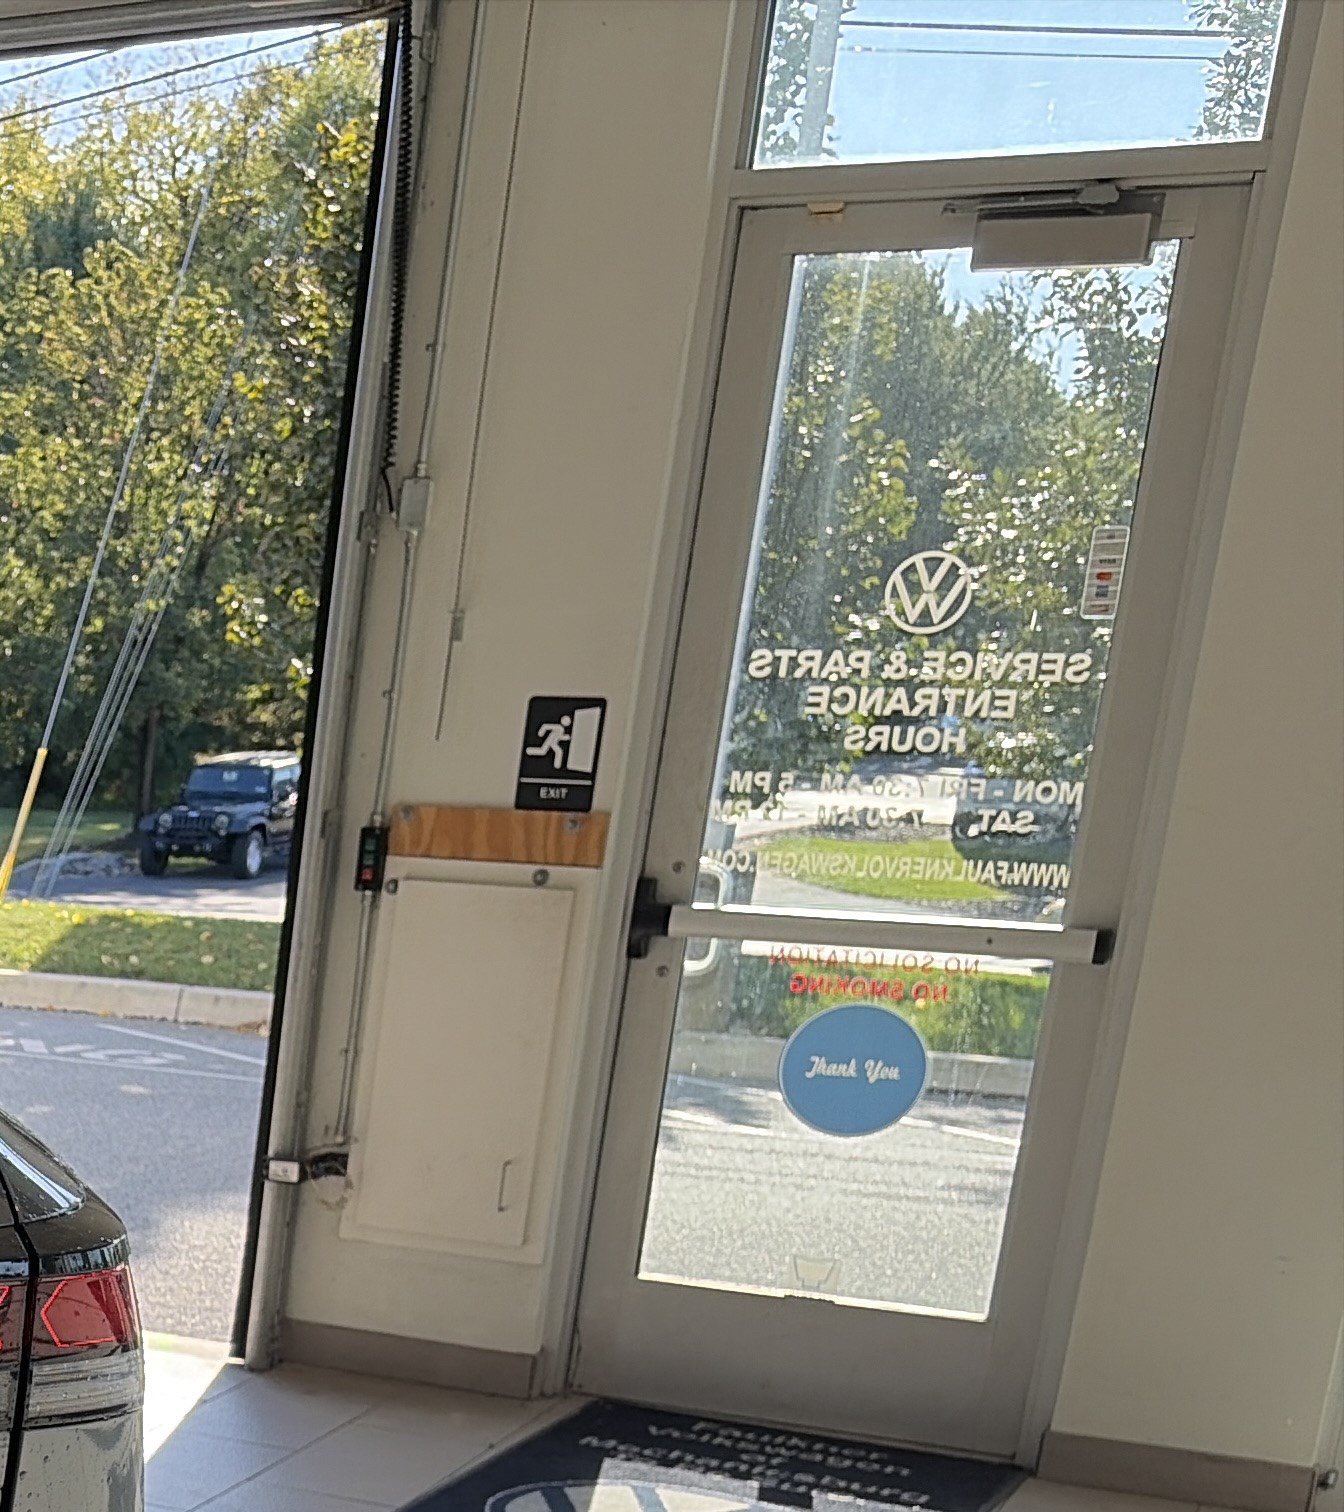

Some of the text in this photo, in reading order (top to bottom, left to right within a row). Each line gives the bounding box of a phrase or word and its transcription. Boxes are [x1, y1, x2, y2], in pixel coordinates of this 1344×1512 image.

[539, 786, 568, 799] EXIT
[805, 1055, 901, 1084] Thank You
